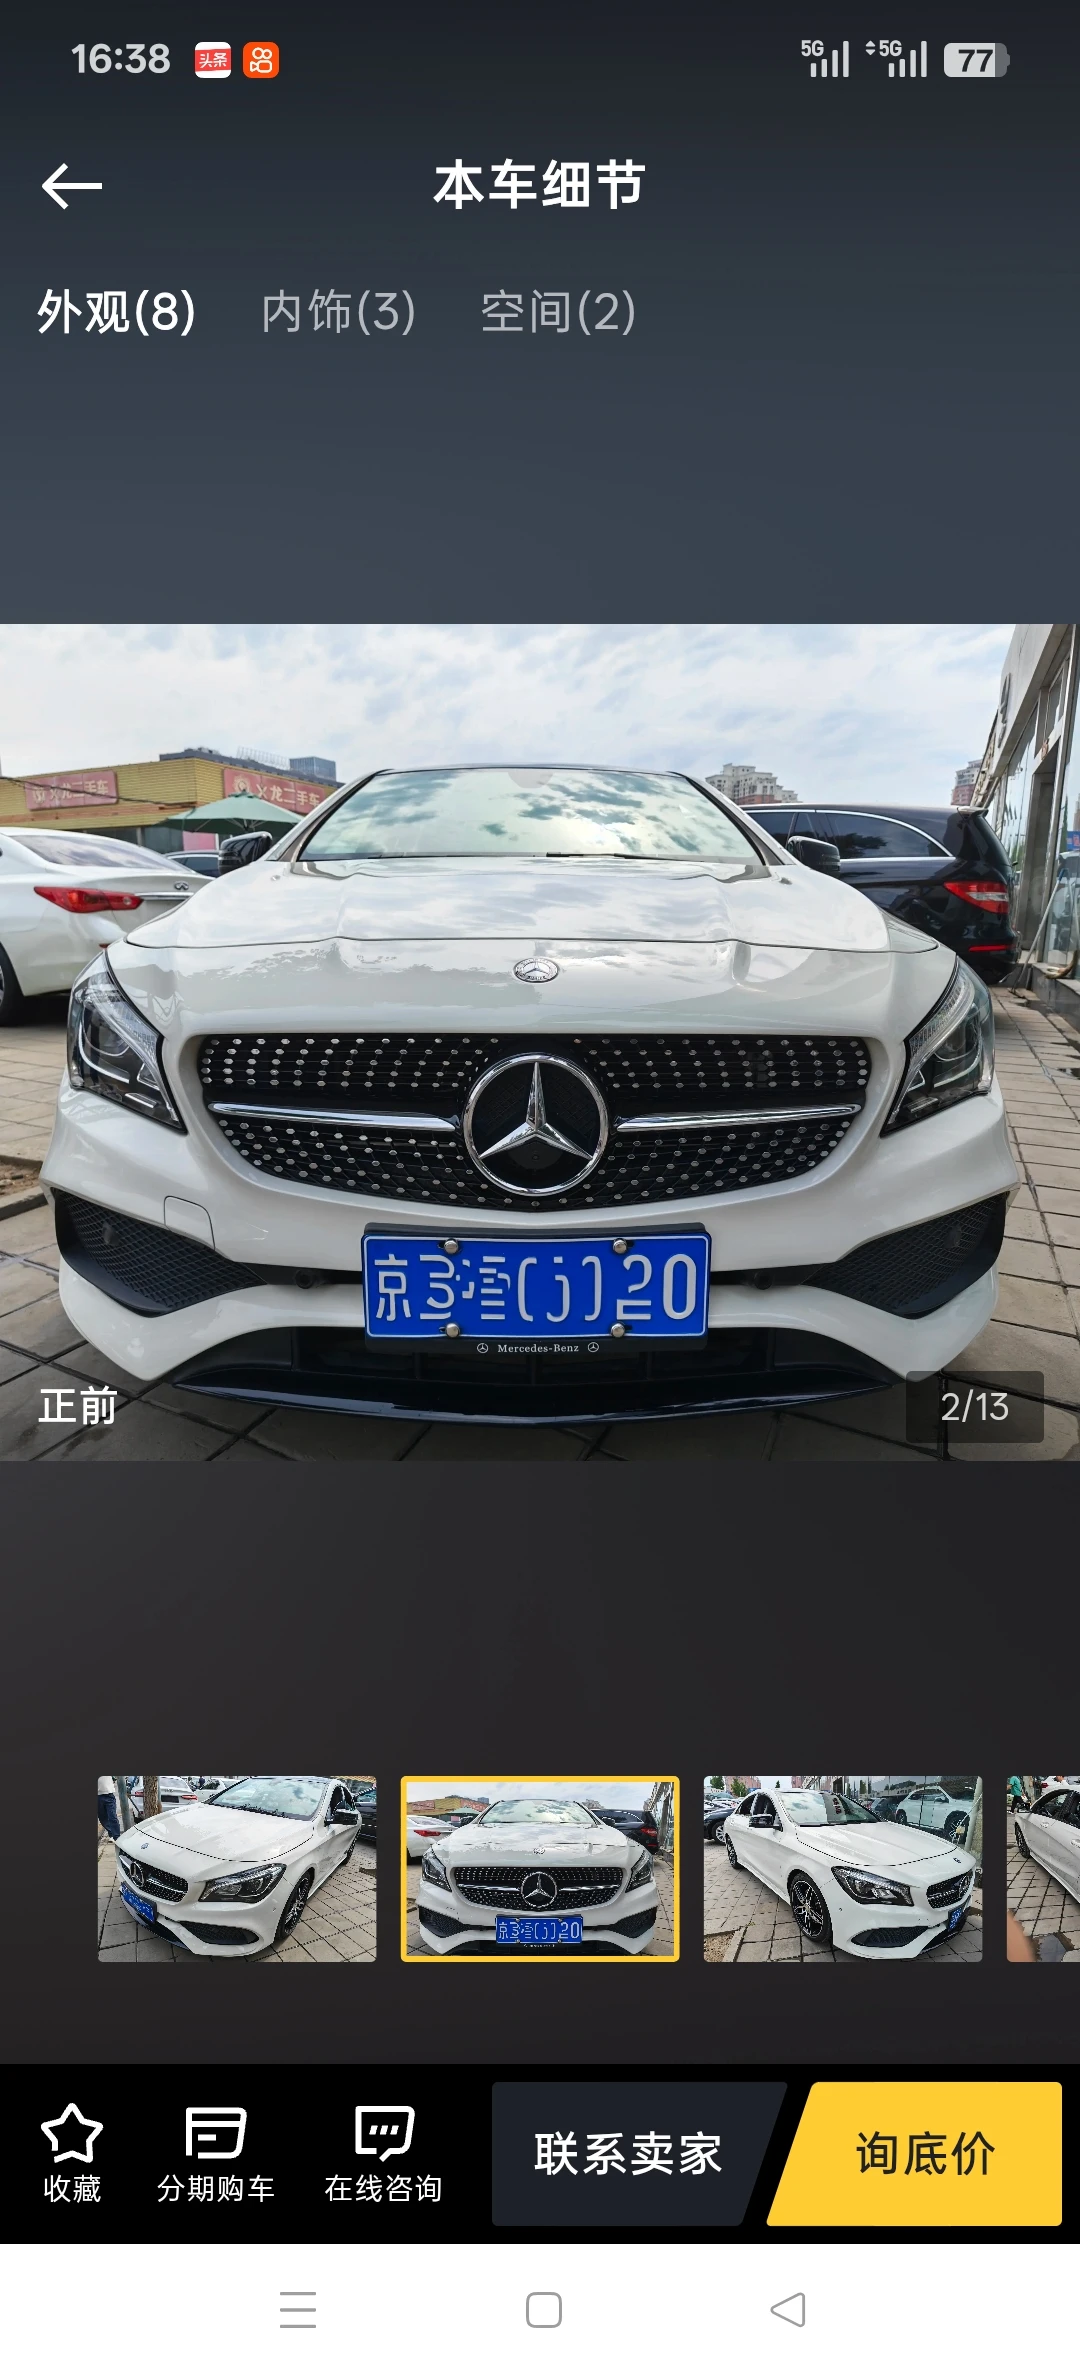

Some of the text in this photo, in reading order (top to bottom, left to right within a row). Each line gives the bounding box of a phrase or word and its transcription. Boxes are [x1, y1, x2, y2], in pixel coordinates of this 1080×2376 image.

[72, 44, 170, 73] 16:38
[199, 52, 227, 68] 头条
[801, 40, 824, 57] 5G
[879, 40, 902, 57] 5G
[958, 49, 993, 73] 77
[433, 159, 645, 209] 本车细节
[37, 289, 194, 336] 外观(8)
[264, 289, 414, 335] 内饰(3)
[482, 289, 634, 335] 空间(2)
[498, 1343, 579, 1353] Mercedes-Benz
[39, 1386, 117, 1424] 正前
[942, 1390, 1008, 1422] 2/13
[535, 2131, 722, 2175] 联系卖家
[857, 2131, 995, 2175] 询底价
[44, 2175, 101, 2203] 收藏
[158, 2175, 274, 2202] 分期购车
[325, 2175, 441, 2202] 在线咨询
